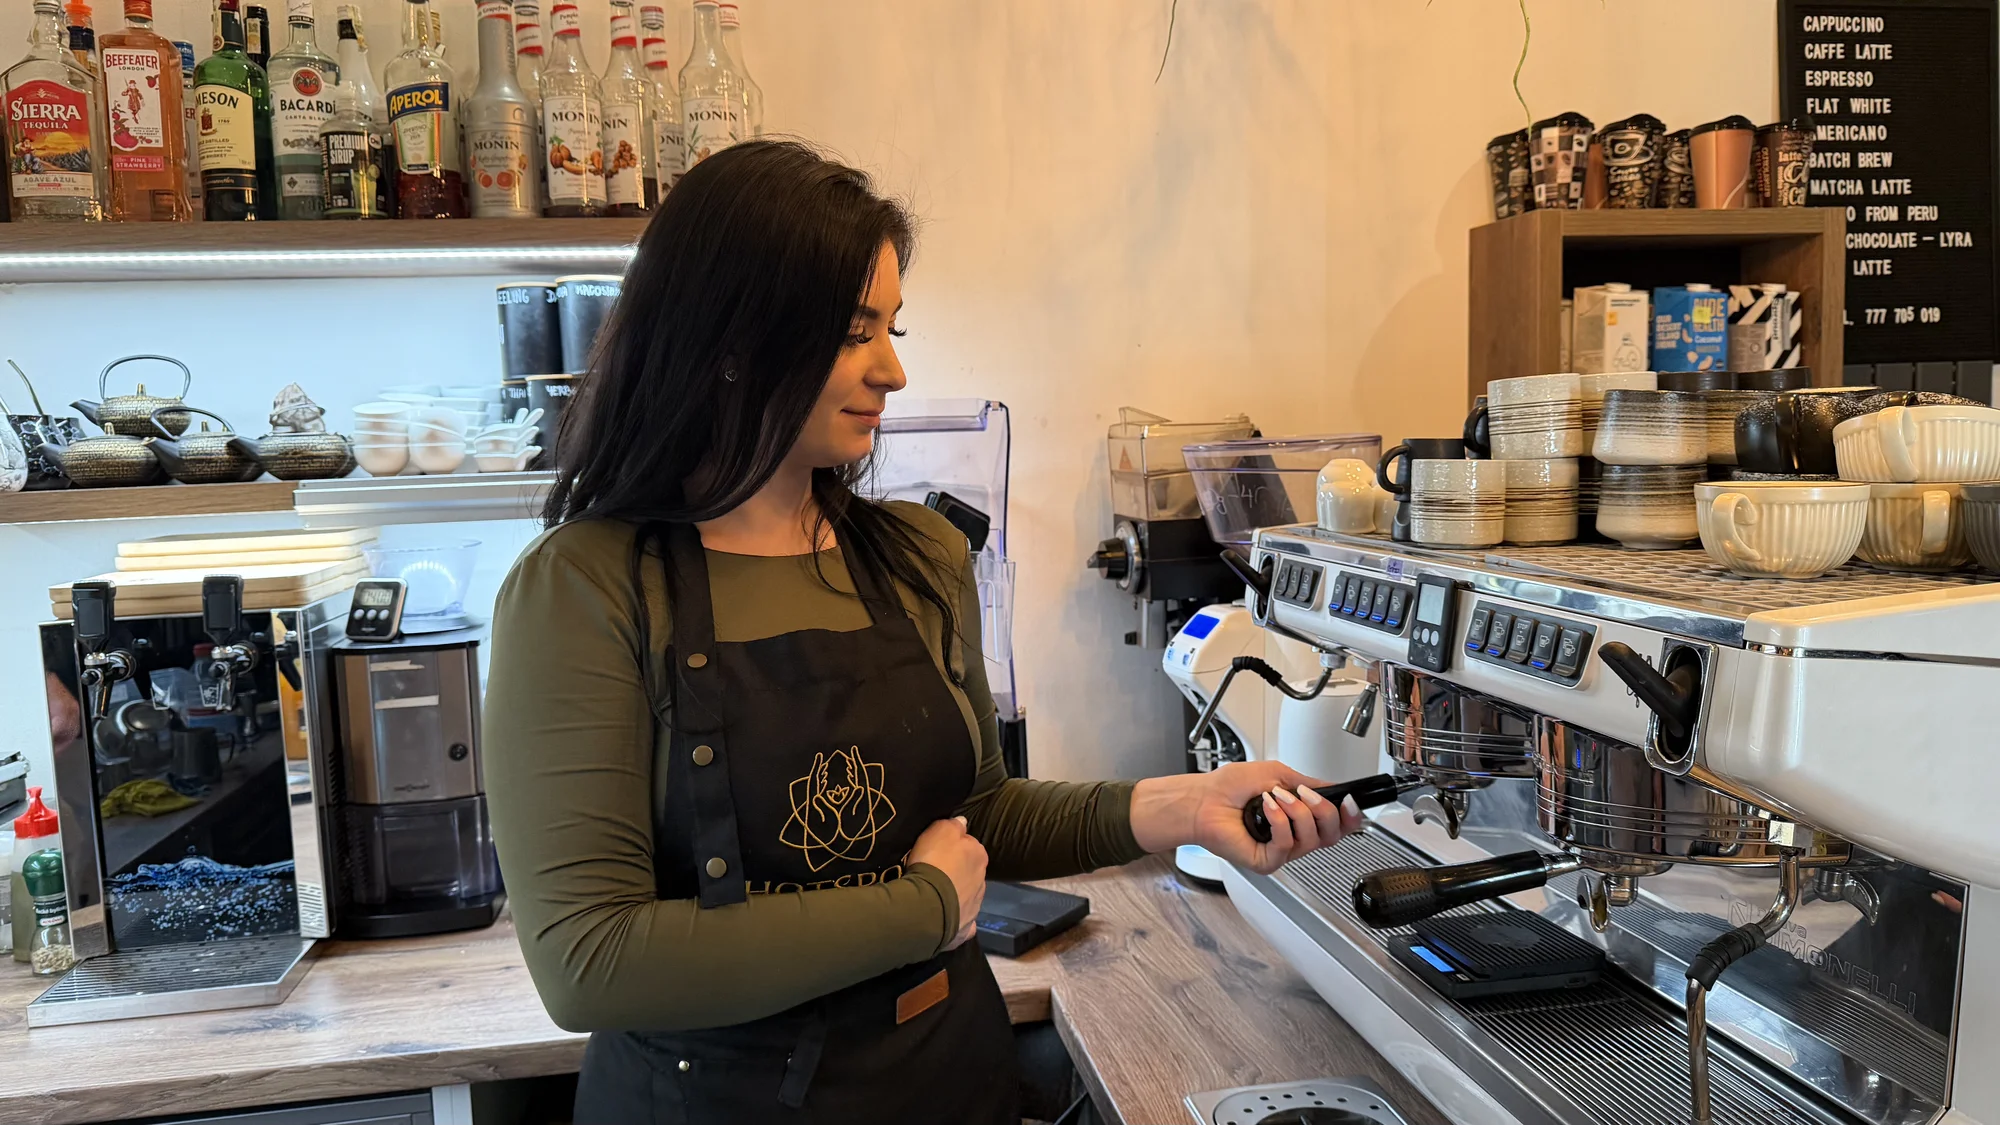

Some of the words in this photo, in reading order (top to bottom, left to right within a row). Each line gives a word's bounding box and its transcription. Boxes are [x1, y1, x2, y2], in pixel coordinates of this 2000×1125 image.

[1803, 15, 1884, 33] CAPPUCCINO
[1804, 43, 1845, 60] CAFFE
[1855, 43, 1893, 60] LATTE
[105, 53, 158, 70] BEEFEATER
[1805, 70, 1874, 87] ESPRESSO
[11, 97, 82, 121] SIERRA
[389, 89, 443, 118] APEROL
[1806, 97, 1840, 114] FLAT
[1850, 97, 1892, 114] WHITE
[552, 111, 600, 124] MONIN
[688, 111, 738, 122] MONIN
[23, 121, 68, 130] TEQUILA
[1810, 125, 1887, 141] MERICANO
[329, 134, 366, 151] PREMIUM
[474, 141, 520, 150] MONIN
[330, 150, 355, 165] SIRUP
[1809, 152, 1851, 168] BATCH
[1857, 152, 1893, 168] BREW
[1810, 179, 1864, 195] MATCHA
[1871, 178, 1912, 195] LATTE
[1865, 206, 1899, 222] FROM
[1907, 205, 1938, 221] PERU
[1845, 232, 1917, 249] CHOCOLATE
[1939, 231, 1973, 248] LYRA
[1853, 259, 1892, 276] LATTE
[1865, 308, 1887, 324] 777
[1893, 306, 1915, 324] 705
[1920, 307, 1941, 323] 019
[1766, 928, 1917, 1016] IMONELLI
